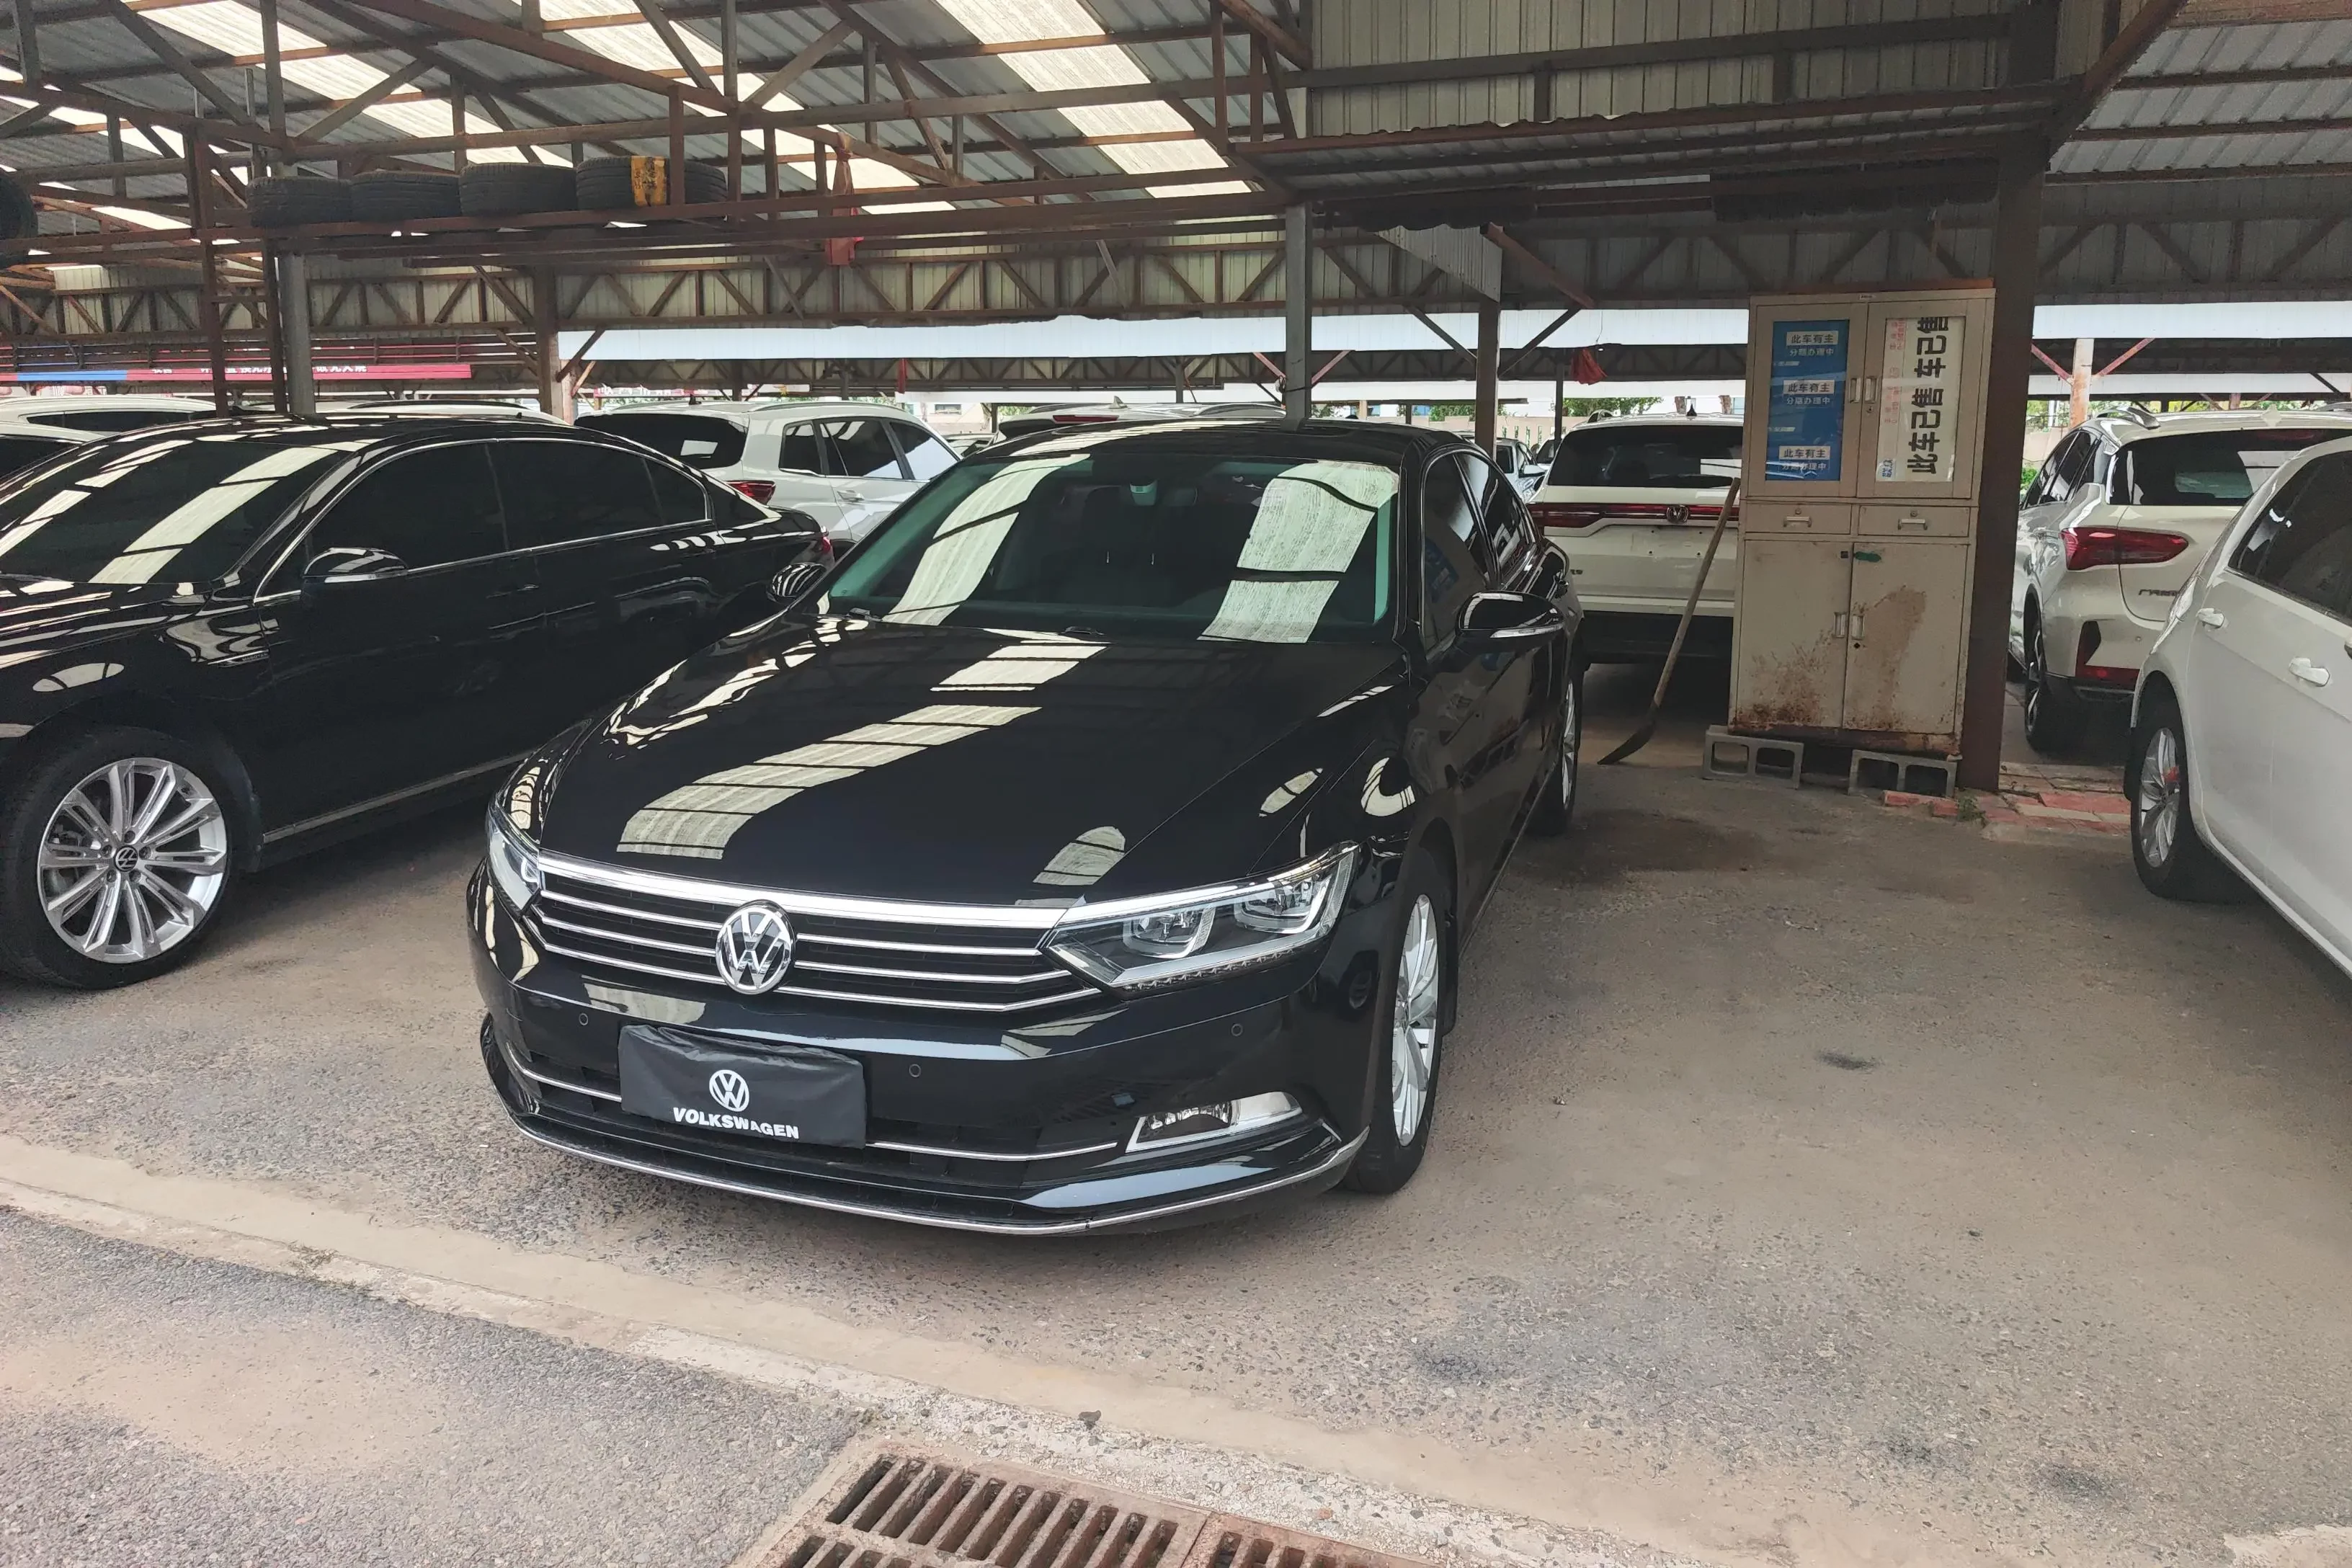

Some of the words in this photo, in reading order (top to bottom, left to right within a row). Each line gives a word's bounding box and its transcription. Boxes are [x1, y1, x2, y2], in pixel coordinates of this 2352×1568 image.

[1791, 334, 1834, 344] 此车有主
[1788, 383, 1830, 393] 此车有主
[1783, 448, 1826, 458] 此车有主
[672, 1108, 800, 1139] VOLKSWAGEN
